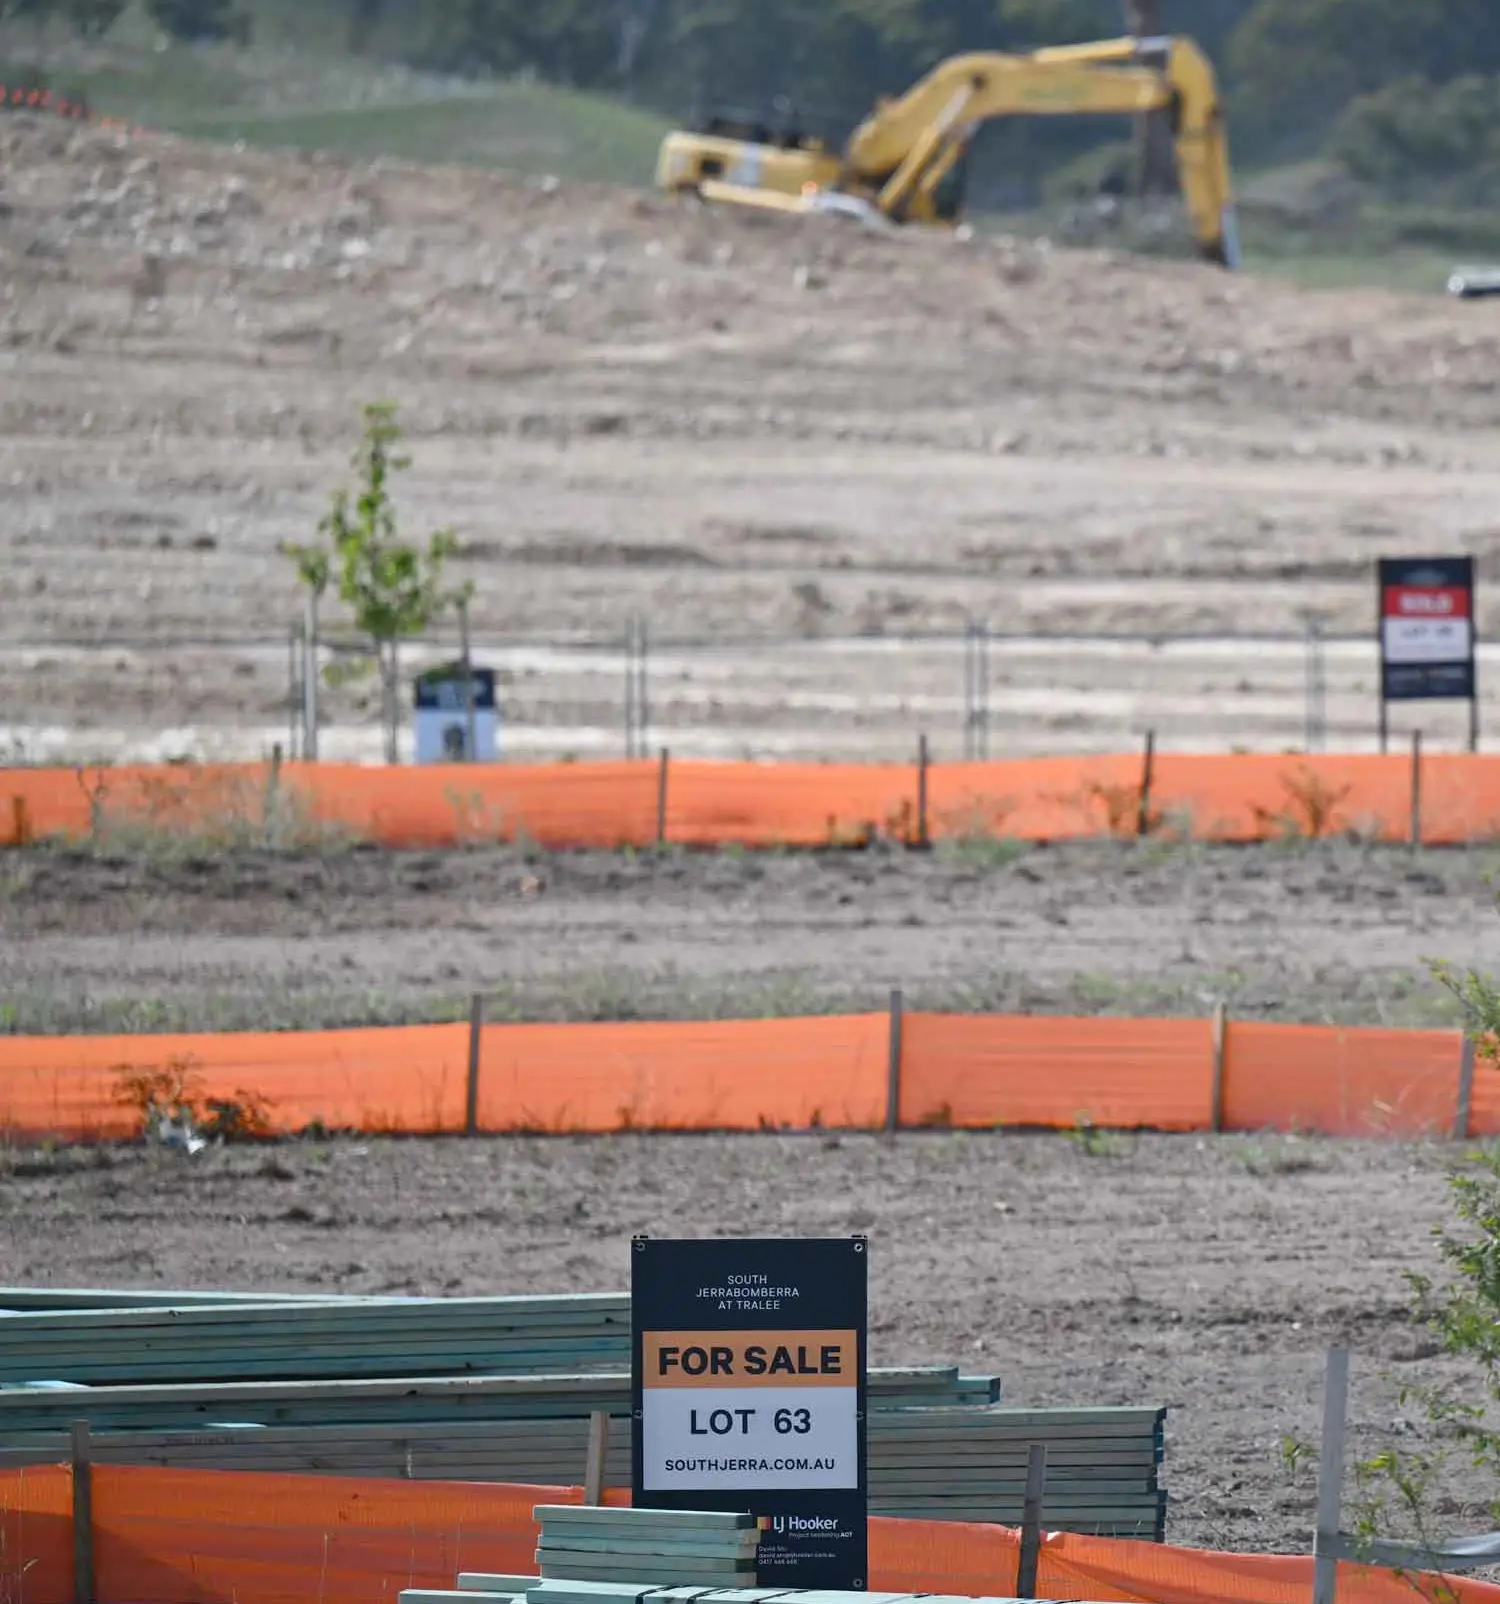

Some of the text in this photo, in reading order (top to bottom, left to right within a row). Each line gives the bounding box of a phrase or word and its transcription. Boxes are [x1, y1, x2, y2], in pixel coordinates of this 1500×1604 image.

[727, 1274, 768, 1285] SOUTH
[696, 1287, 800, 1298] JERRABOMBERRA
[718, 1300, 781, 1310] AT TRALEE
[658, 1345, 842, 1376] FOR SALE
[690, 1408, 812, 1435] LOT 63
[665, 1458, 836, 1471] SOUTHJERRA.COM.AU
[773, 1516, 839, 1533] LJ Hooker
